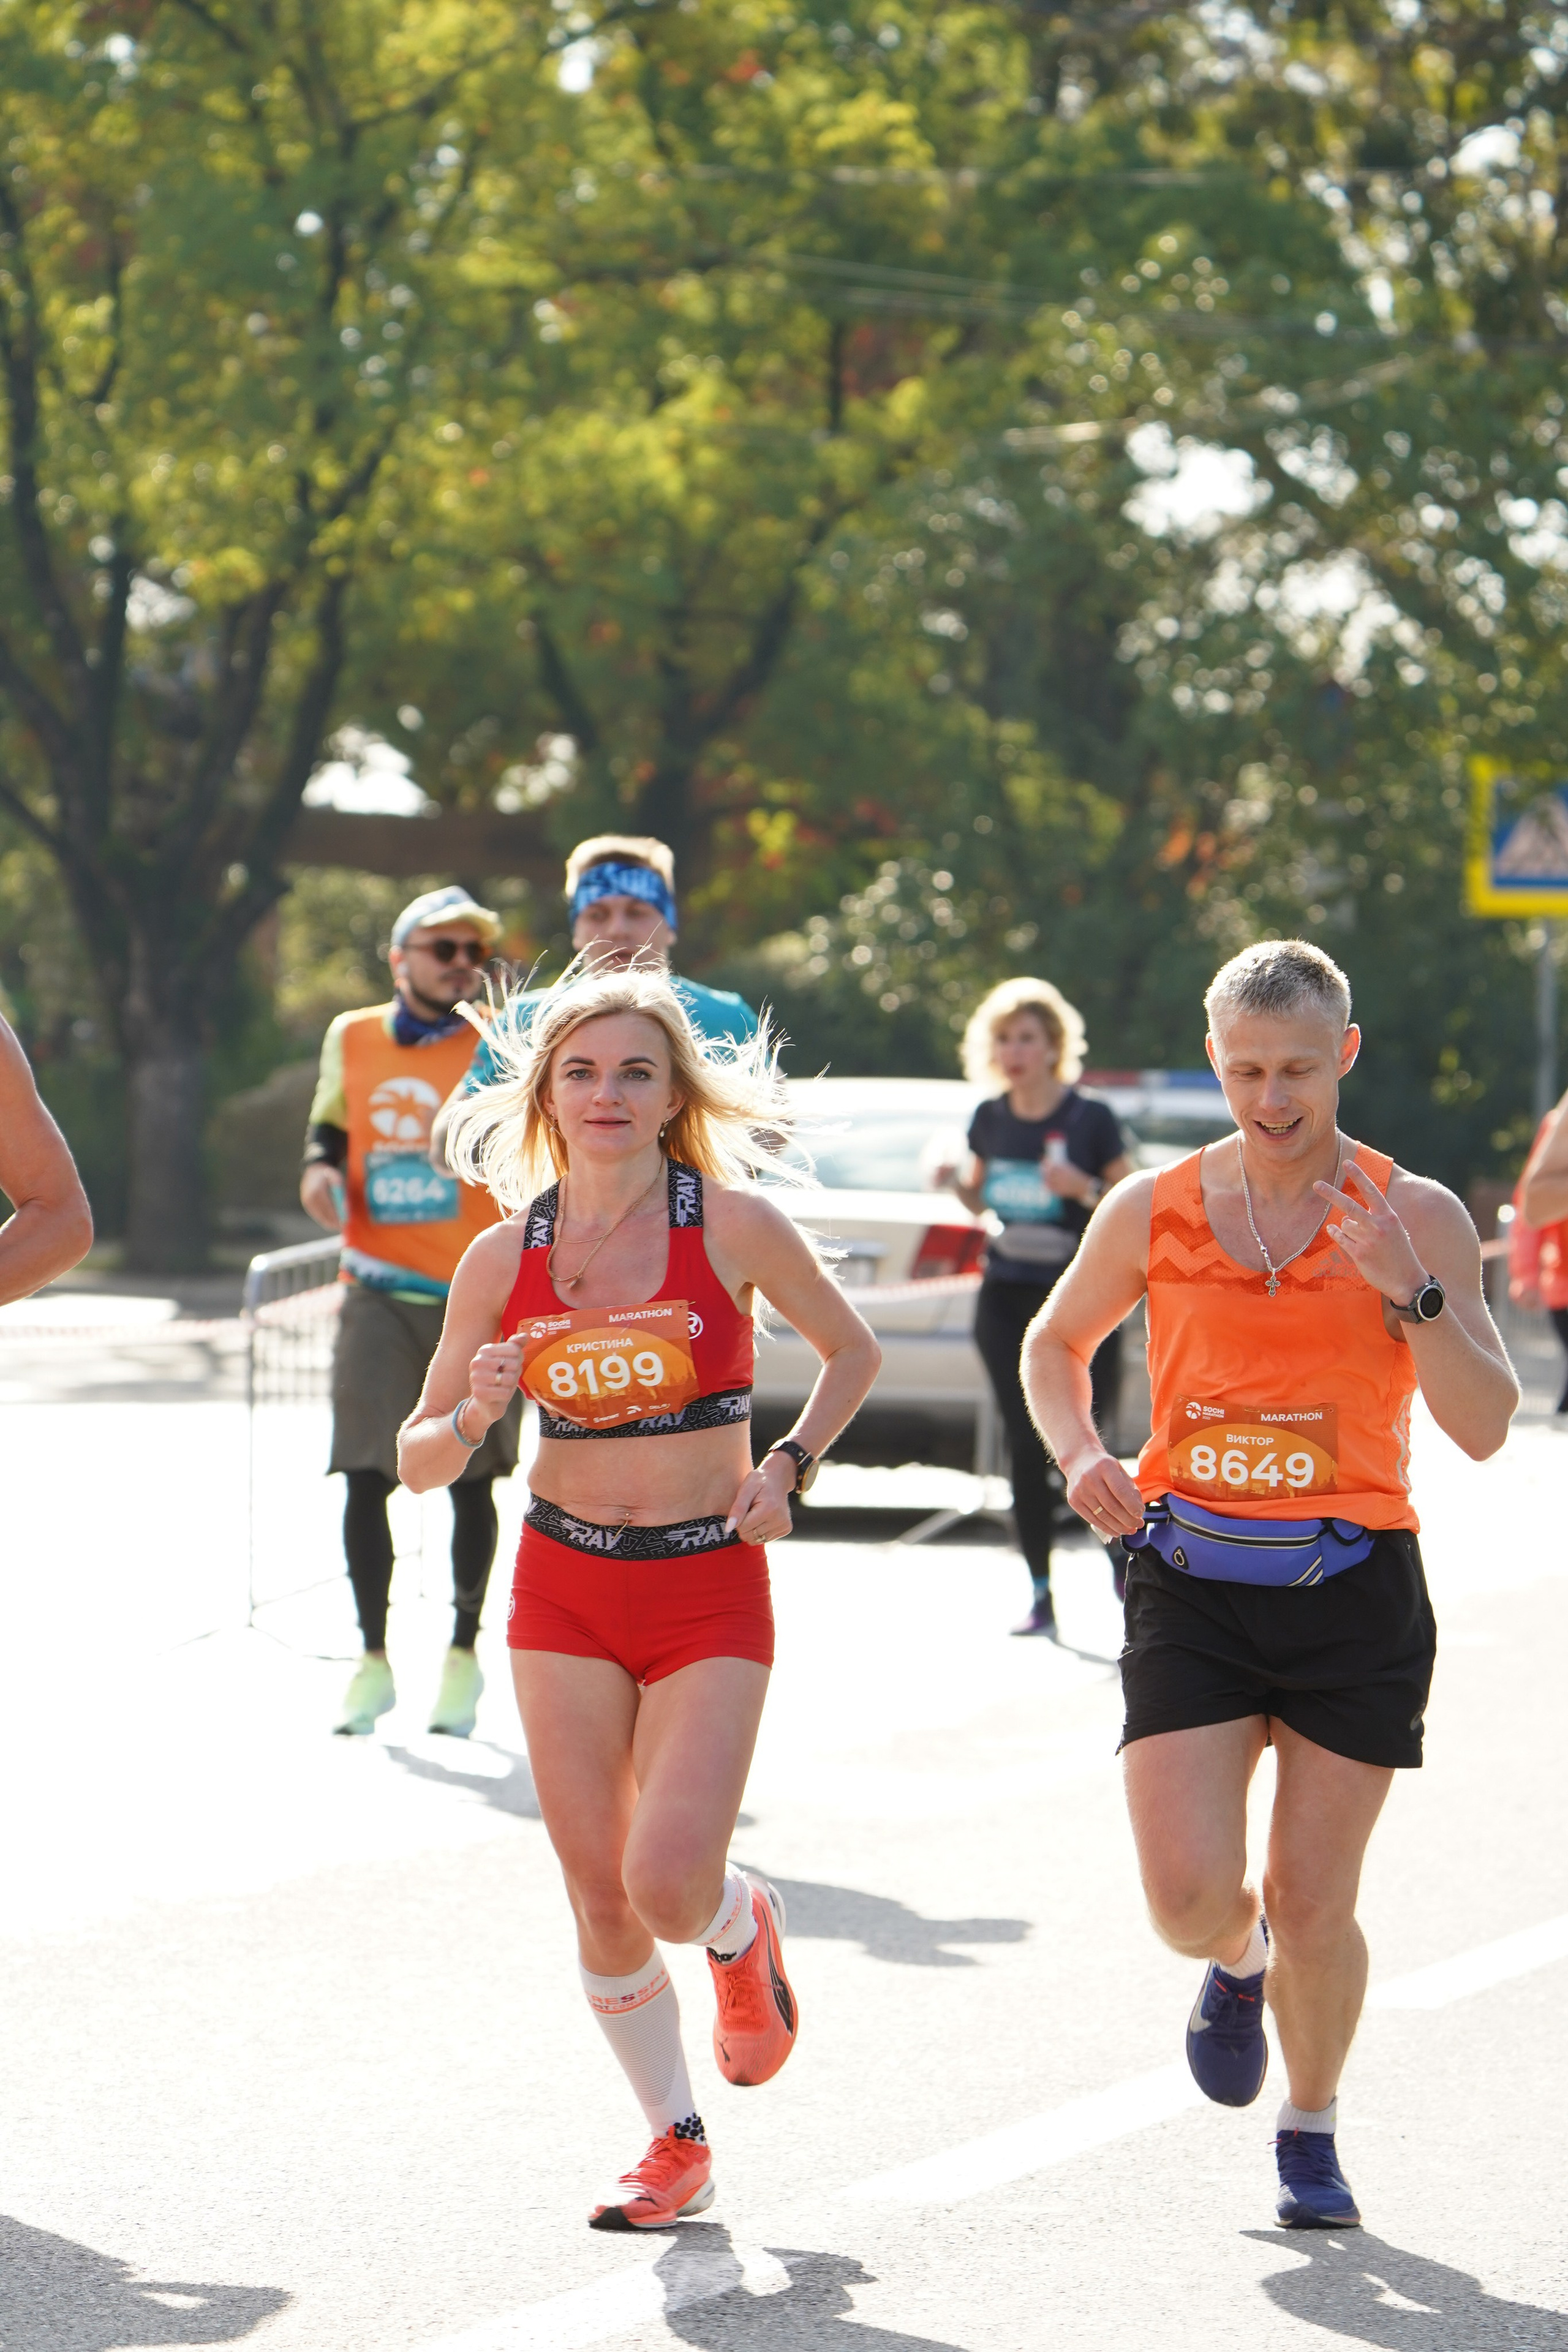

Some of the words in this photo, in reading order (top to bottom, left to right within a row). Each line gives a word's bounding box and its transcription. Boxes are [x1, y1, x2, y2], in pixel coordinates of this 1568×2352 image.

[609, 1308, 673, 1322] MARATHON
[567, 1337, 634, 1354] КРИСТИНА
[548, 1351, 664, 1398] 8199
[1203, 1406, 1224, 1414] SOCHI
[1261, 1412, 1323, 1422] MARATHON
[1226, 1434, 1274, 1446] ВИКТОР
[1190, 1445, 1314, 1488] 8649
